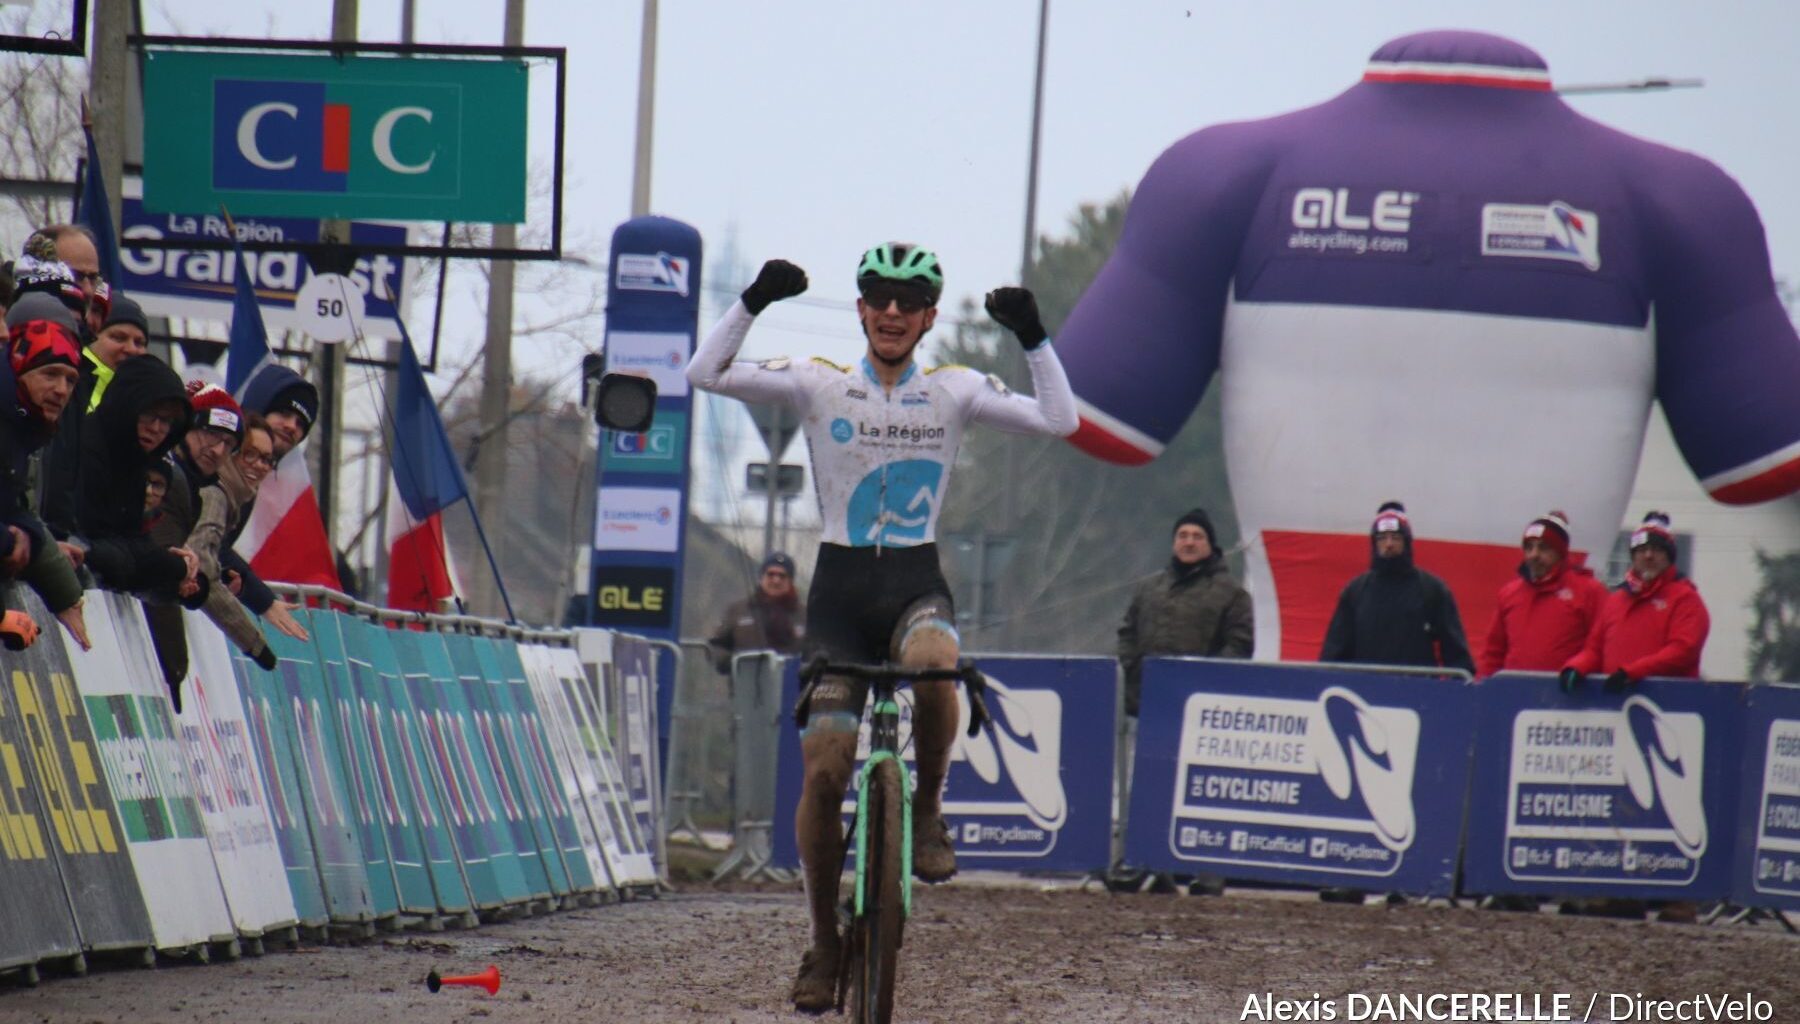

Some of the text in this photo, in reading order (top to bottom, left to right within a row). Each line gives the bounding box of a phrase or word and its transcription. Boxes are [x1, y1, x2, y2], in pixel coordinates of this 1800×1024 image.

[237, 102, 436, 174] CIC
[168, 213, 196, 234] La
[1287, 230, 1408, 255] alecycling.com
[317, 298, 343, 317] 50
[859, 421, 945, 443] La Région
[1200, 705, 1309, 736] FÉDÉRATION
[1526, 721, 1616, 748] FÉDÉRATION
[1196, 736, 1305, 765] FRANÇAISE
[1523, 754, 1613, 779] FRANÇAISE
[1205, 776, 1301, 804] CYCLISME
[1534, 793, 1612, 817] CYCLISME
